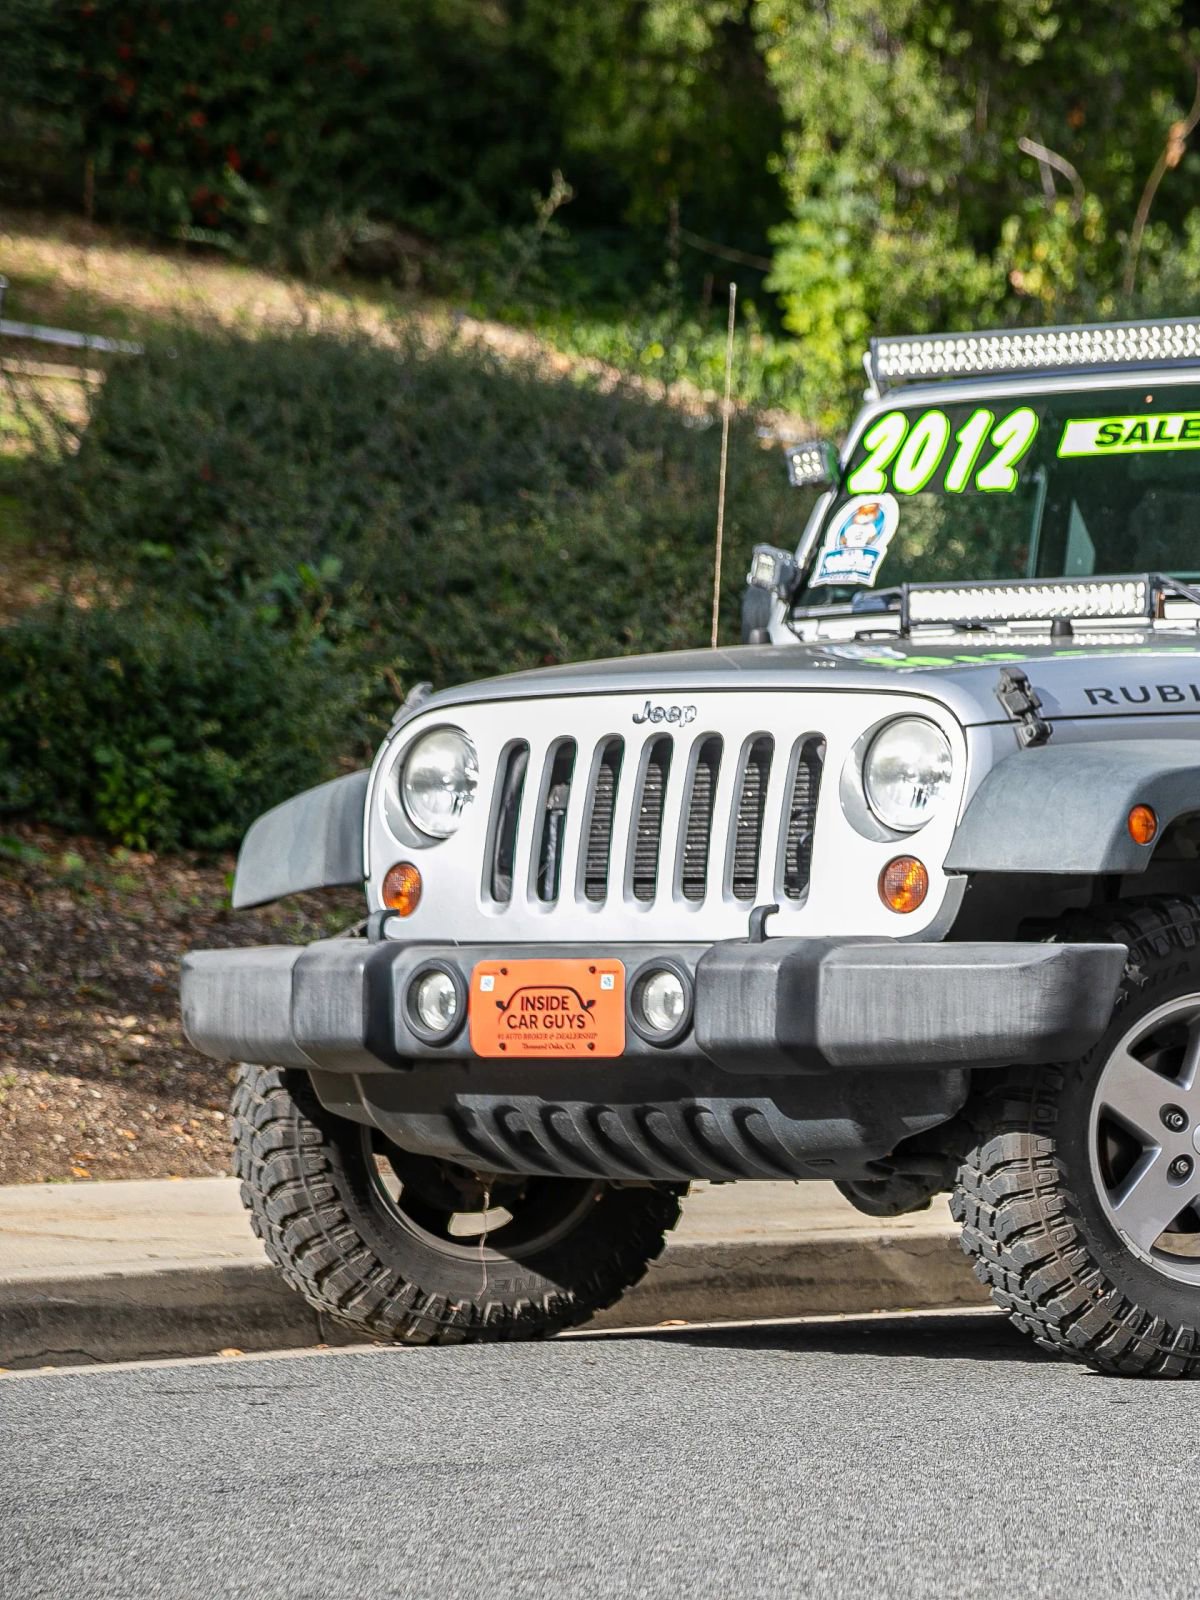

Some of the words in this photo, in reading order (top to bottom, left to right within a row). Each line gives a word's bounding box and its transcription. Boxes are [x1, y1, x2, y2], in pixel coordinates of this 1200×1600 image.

[847, 407, 1040, 496] 2012
[632, 700, 698, 728] Jeep
[520, 995, 570, 1011] INSIDE
[507, 1014, 538, 1029] CAR
[543, 1014, 586, 1029] GUYS
